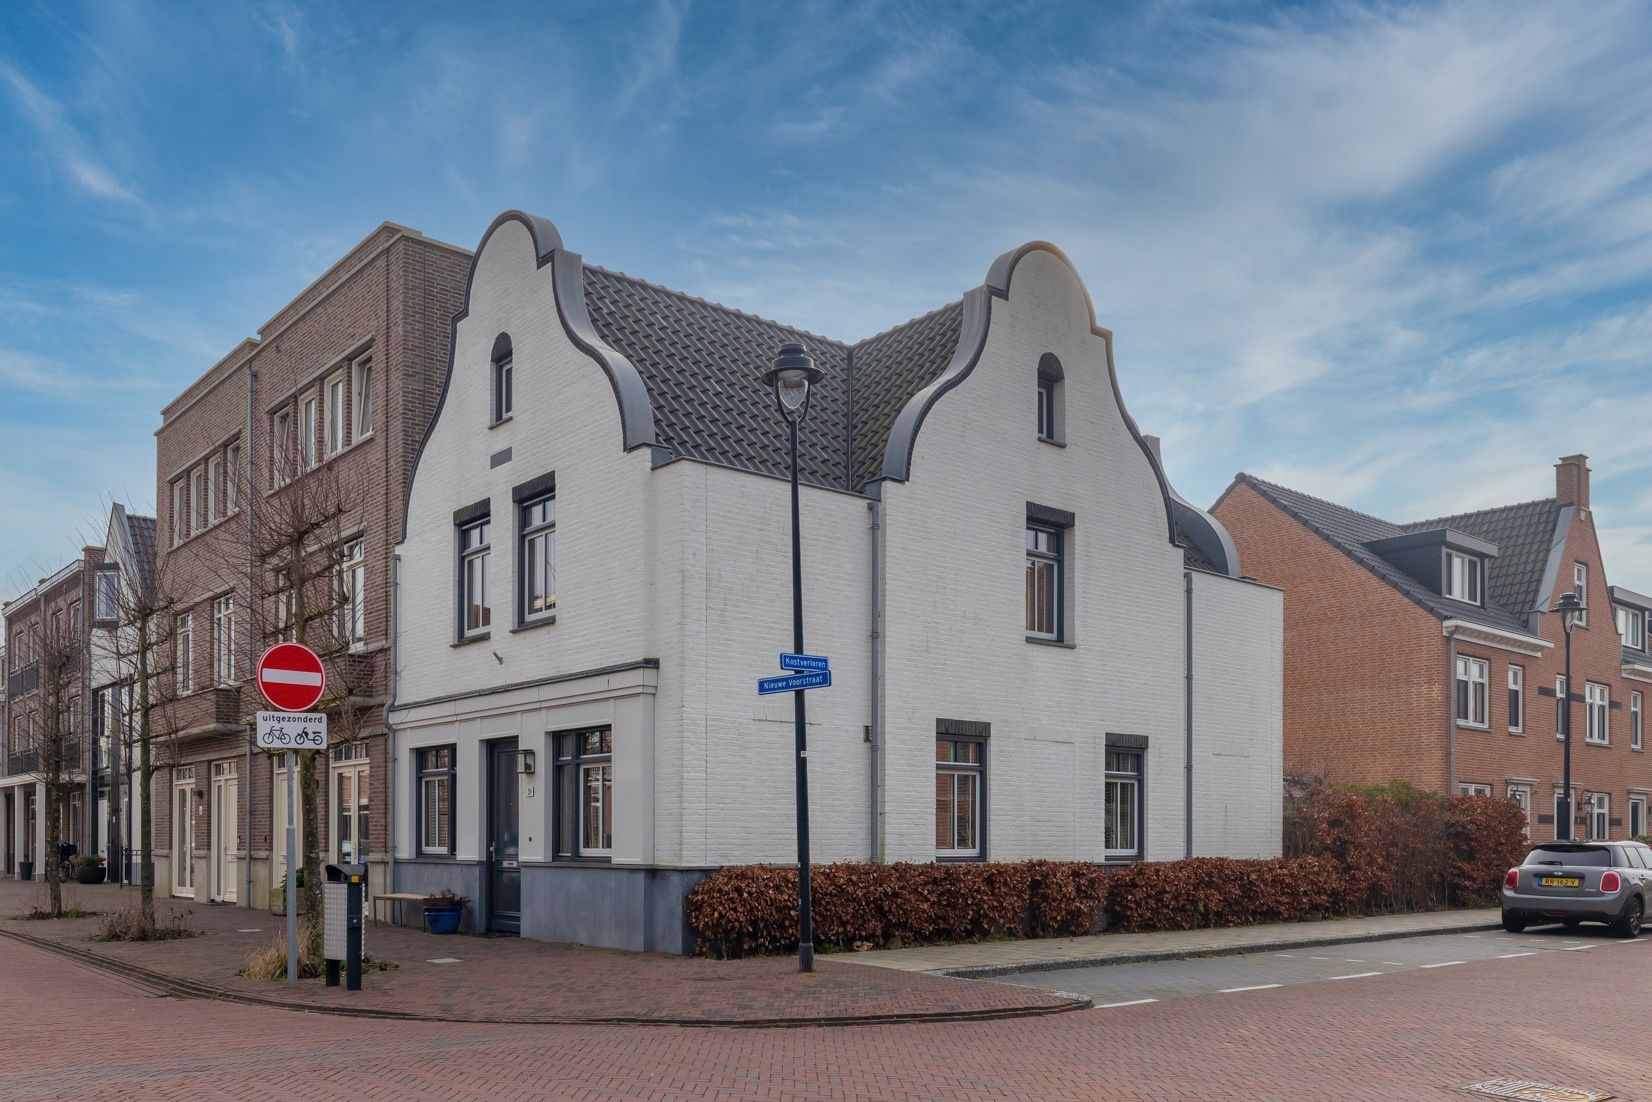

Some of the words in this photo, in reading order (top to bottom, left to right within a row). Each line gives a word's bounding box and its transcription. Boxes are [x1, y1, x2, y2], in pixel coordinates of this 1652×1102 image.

[785, 657, 826, 668] Kostverloren
[763, 681, 786, 689] Nieuwe
[788, 675, 823, 686] Voorstraat
[262, 714, 323, 724] uitgezonderd
